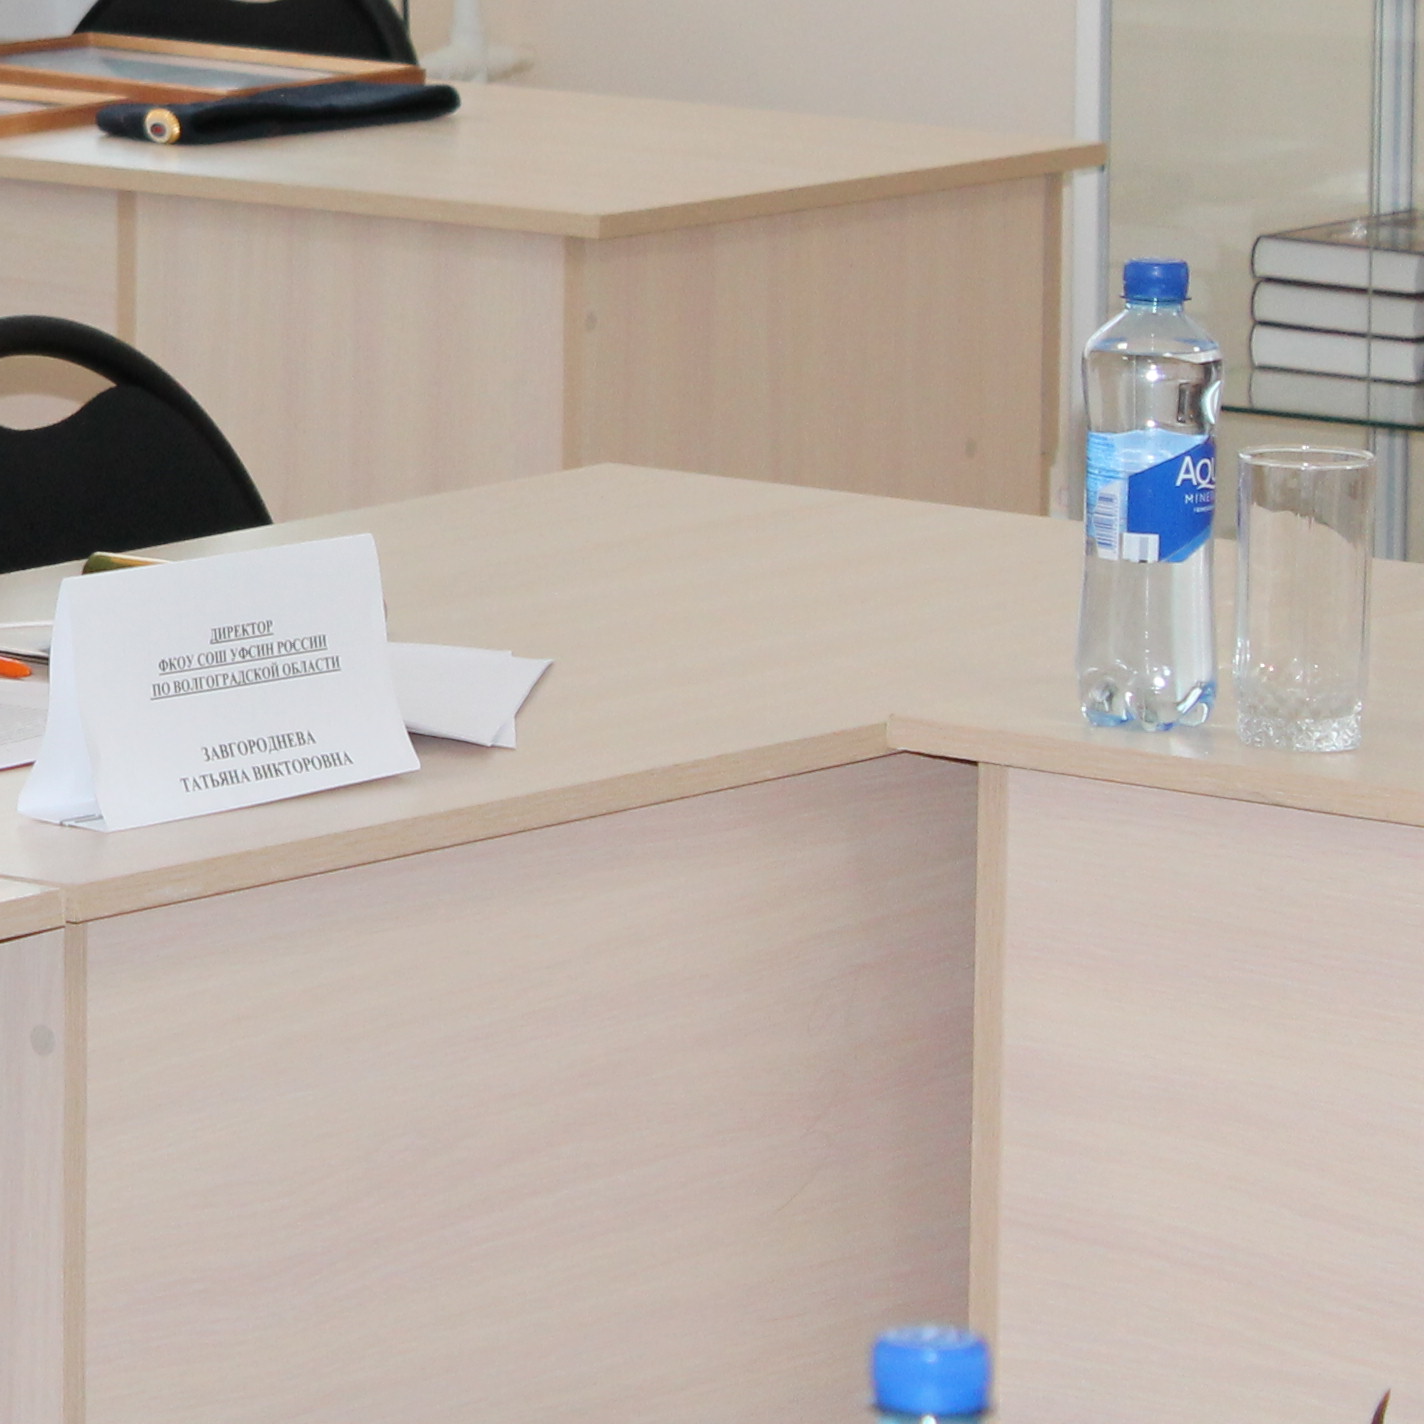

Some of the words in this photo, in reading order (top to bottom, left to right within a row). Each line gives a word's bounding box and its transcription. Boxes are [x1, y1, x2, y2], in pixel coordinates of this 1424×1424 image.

[210, 619, 273, 643] ДИРЕКТОР
[158, 654, 194, 674] ФКОУ
[197, 649, 228, 668] СОШ
[230, 641, 276, 663] УФСИН
[277, 634, 327, 656] РОССИИ
[151, 680, 171, 699] ПО
[173, 662, 280, 695] ВОЛГОГРАДСКОЙ
[282, 655, 341, 678] ОБЛАСТИ
[202, 730, 317, 762] ЗАВГОРОДНЕВА
[180, 770, 252, 794] ТАТЬЯНА
[253, 751, 353, 781] ВИКТОРОВНА
